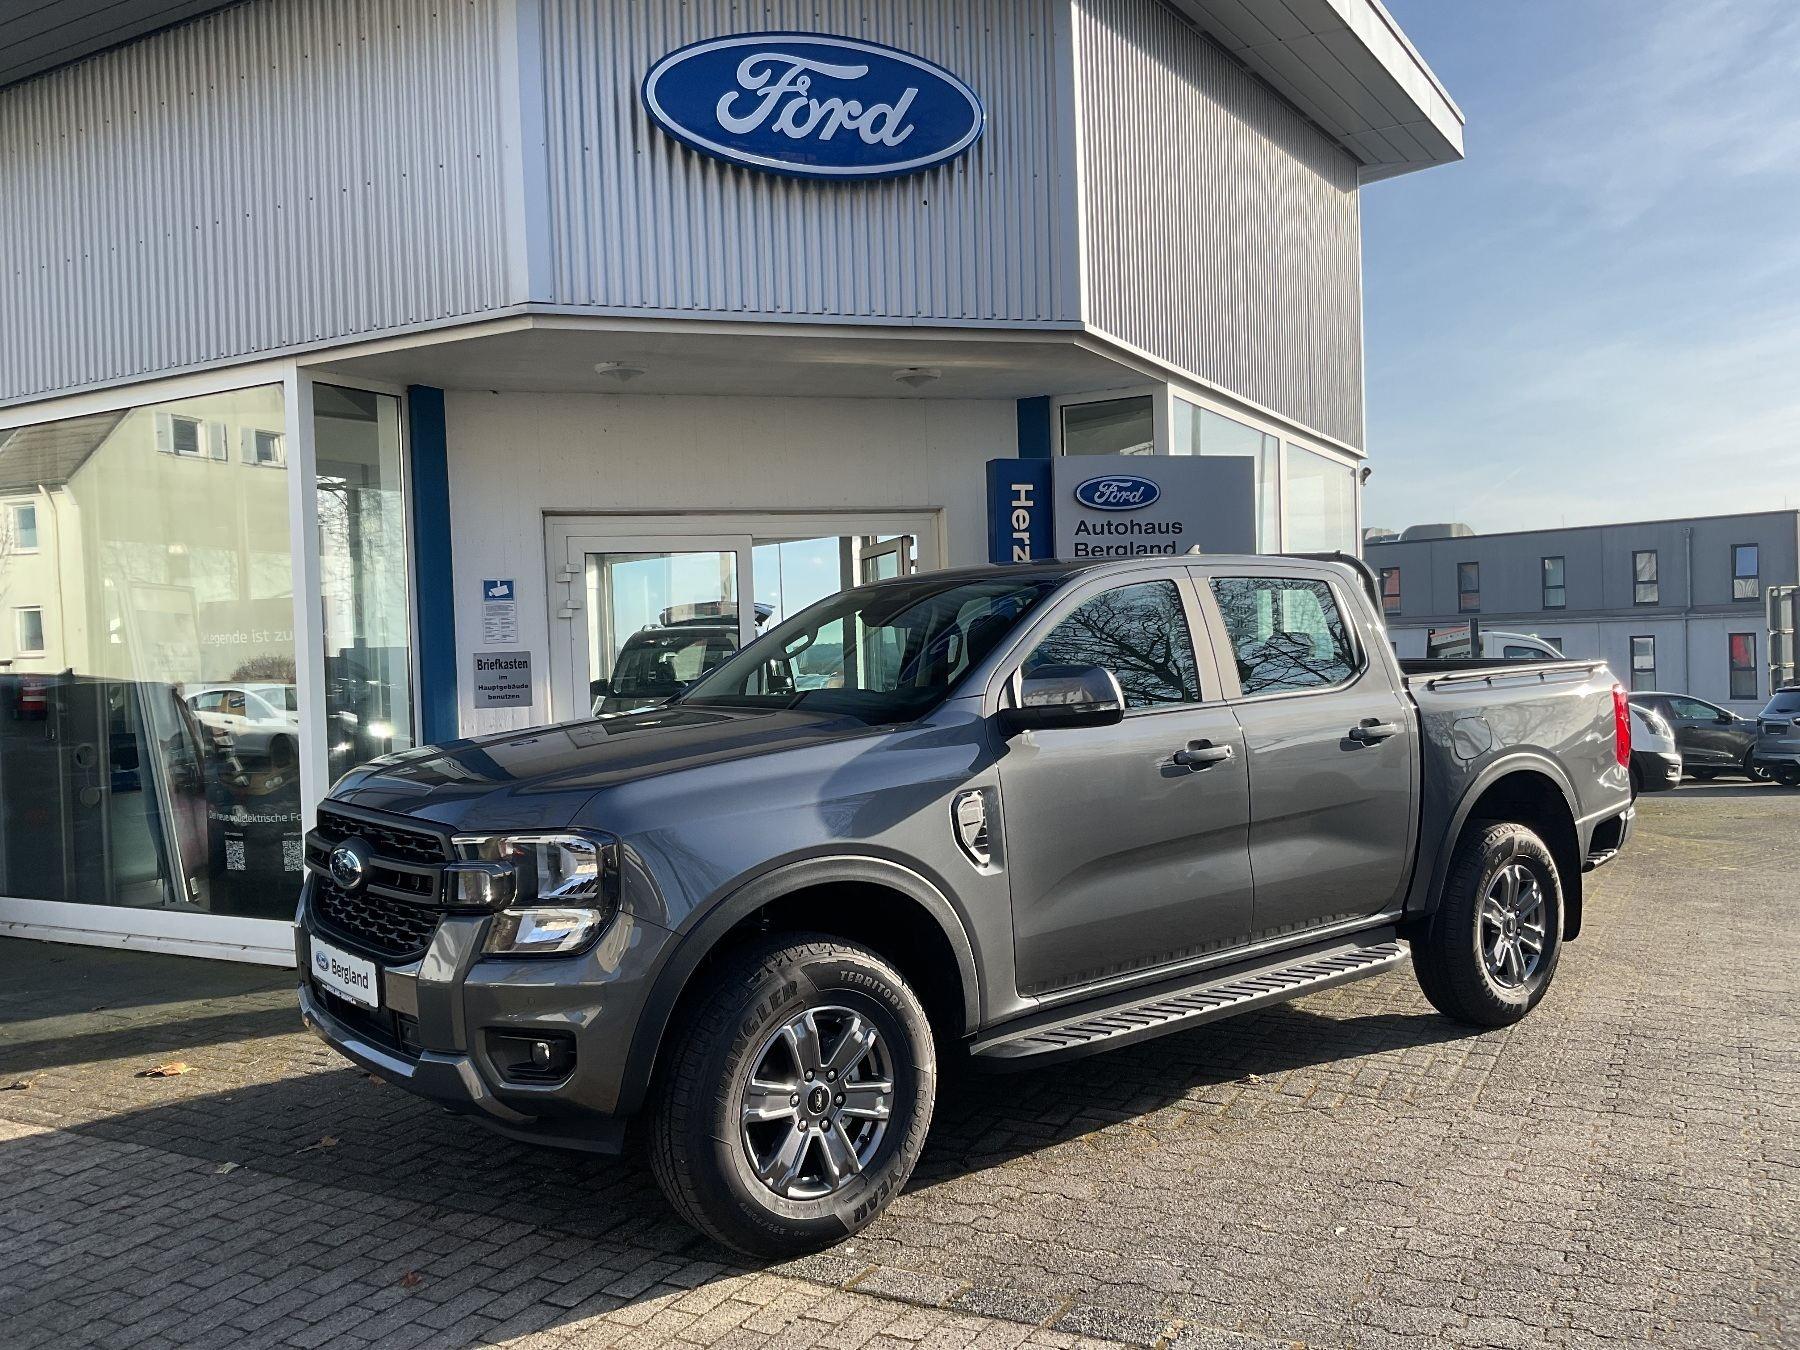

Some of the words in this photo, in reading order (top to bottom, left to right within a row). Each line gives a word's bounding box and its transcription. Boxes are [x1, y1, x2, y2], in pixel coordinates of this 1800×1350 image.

[716, 52, 919, 147] Ford
[1093, 480, 1145, 503] Ford
[1011, 483, 1034, 563] Herz
[1074, 519, 1183, 536] Autohaus
[1074, 540, 1177, 558] Bergland
[251, 628, 270, 643] ist
[476, 658, 528, 671] Briefkasten
[478, 683, 529, 692] Hauptgebäude
[331, 957, 369, 990] Bergland
[840, 970, 906, 1011] TERRITORY
